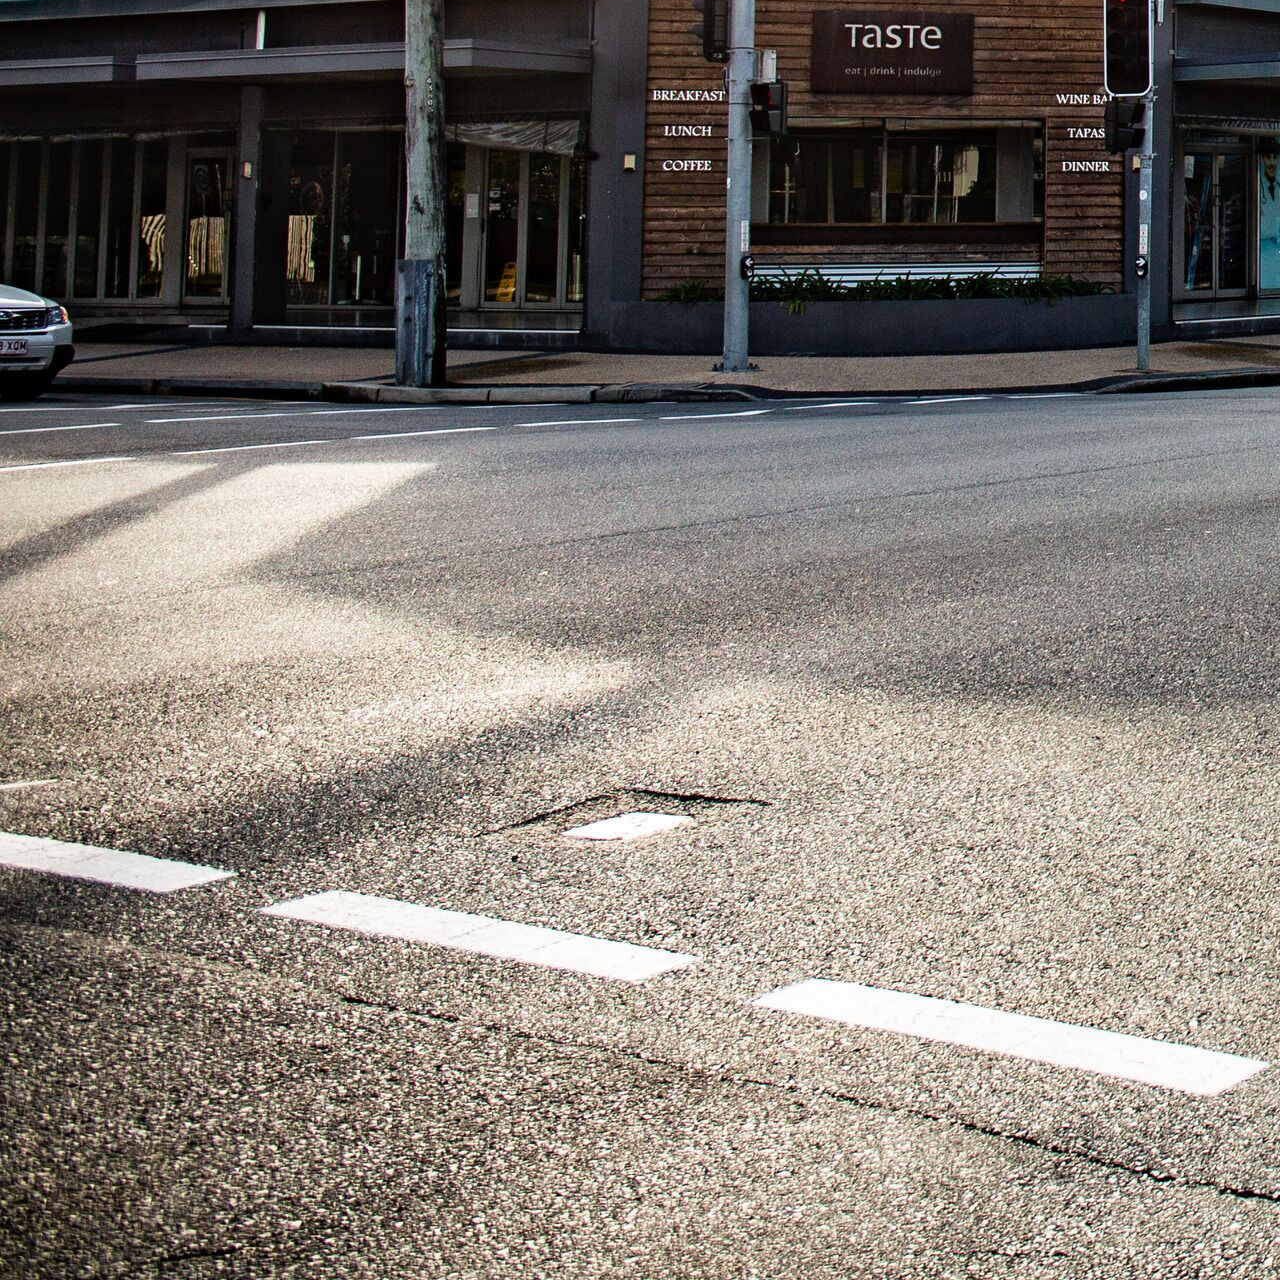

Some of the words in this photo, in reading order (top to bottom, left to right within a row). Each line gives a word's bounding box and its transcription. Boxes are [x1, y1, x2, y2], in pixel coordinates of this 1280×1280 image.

[845, 67, 861, 75] eat
[870, 66, 896, 75] drink
[903, 66, 942, 77] indulge
[652, 90, 726, 101] BREAKFAST
[1056, 94, 1090, 105] WINE
[664, 125, 713, 136] LUNCH
[1067, 127, 1105, 138] TAPAS
[662, 160, 712, 171] COFFEE
[1061, 161, 1110, 172] DINNER
